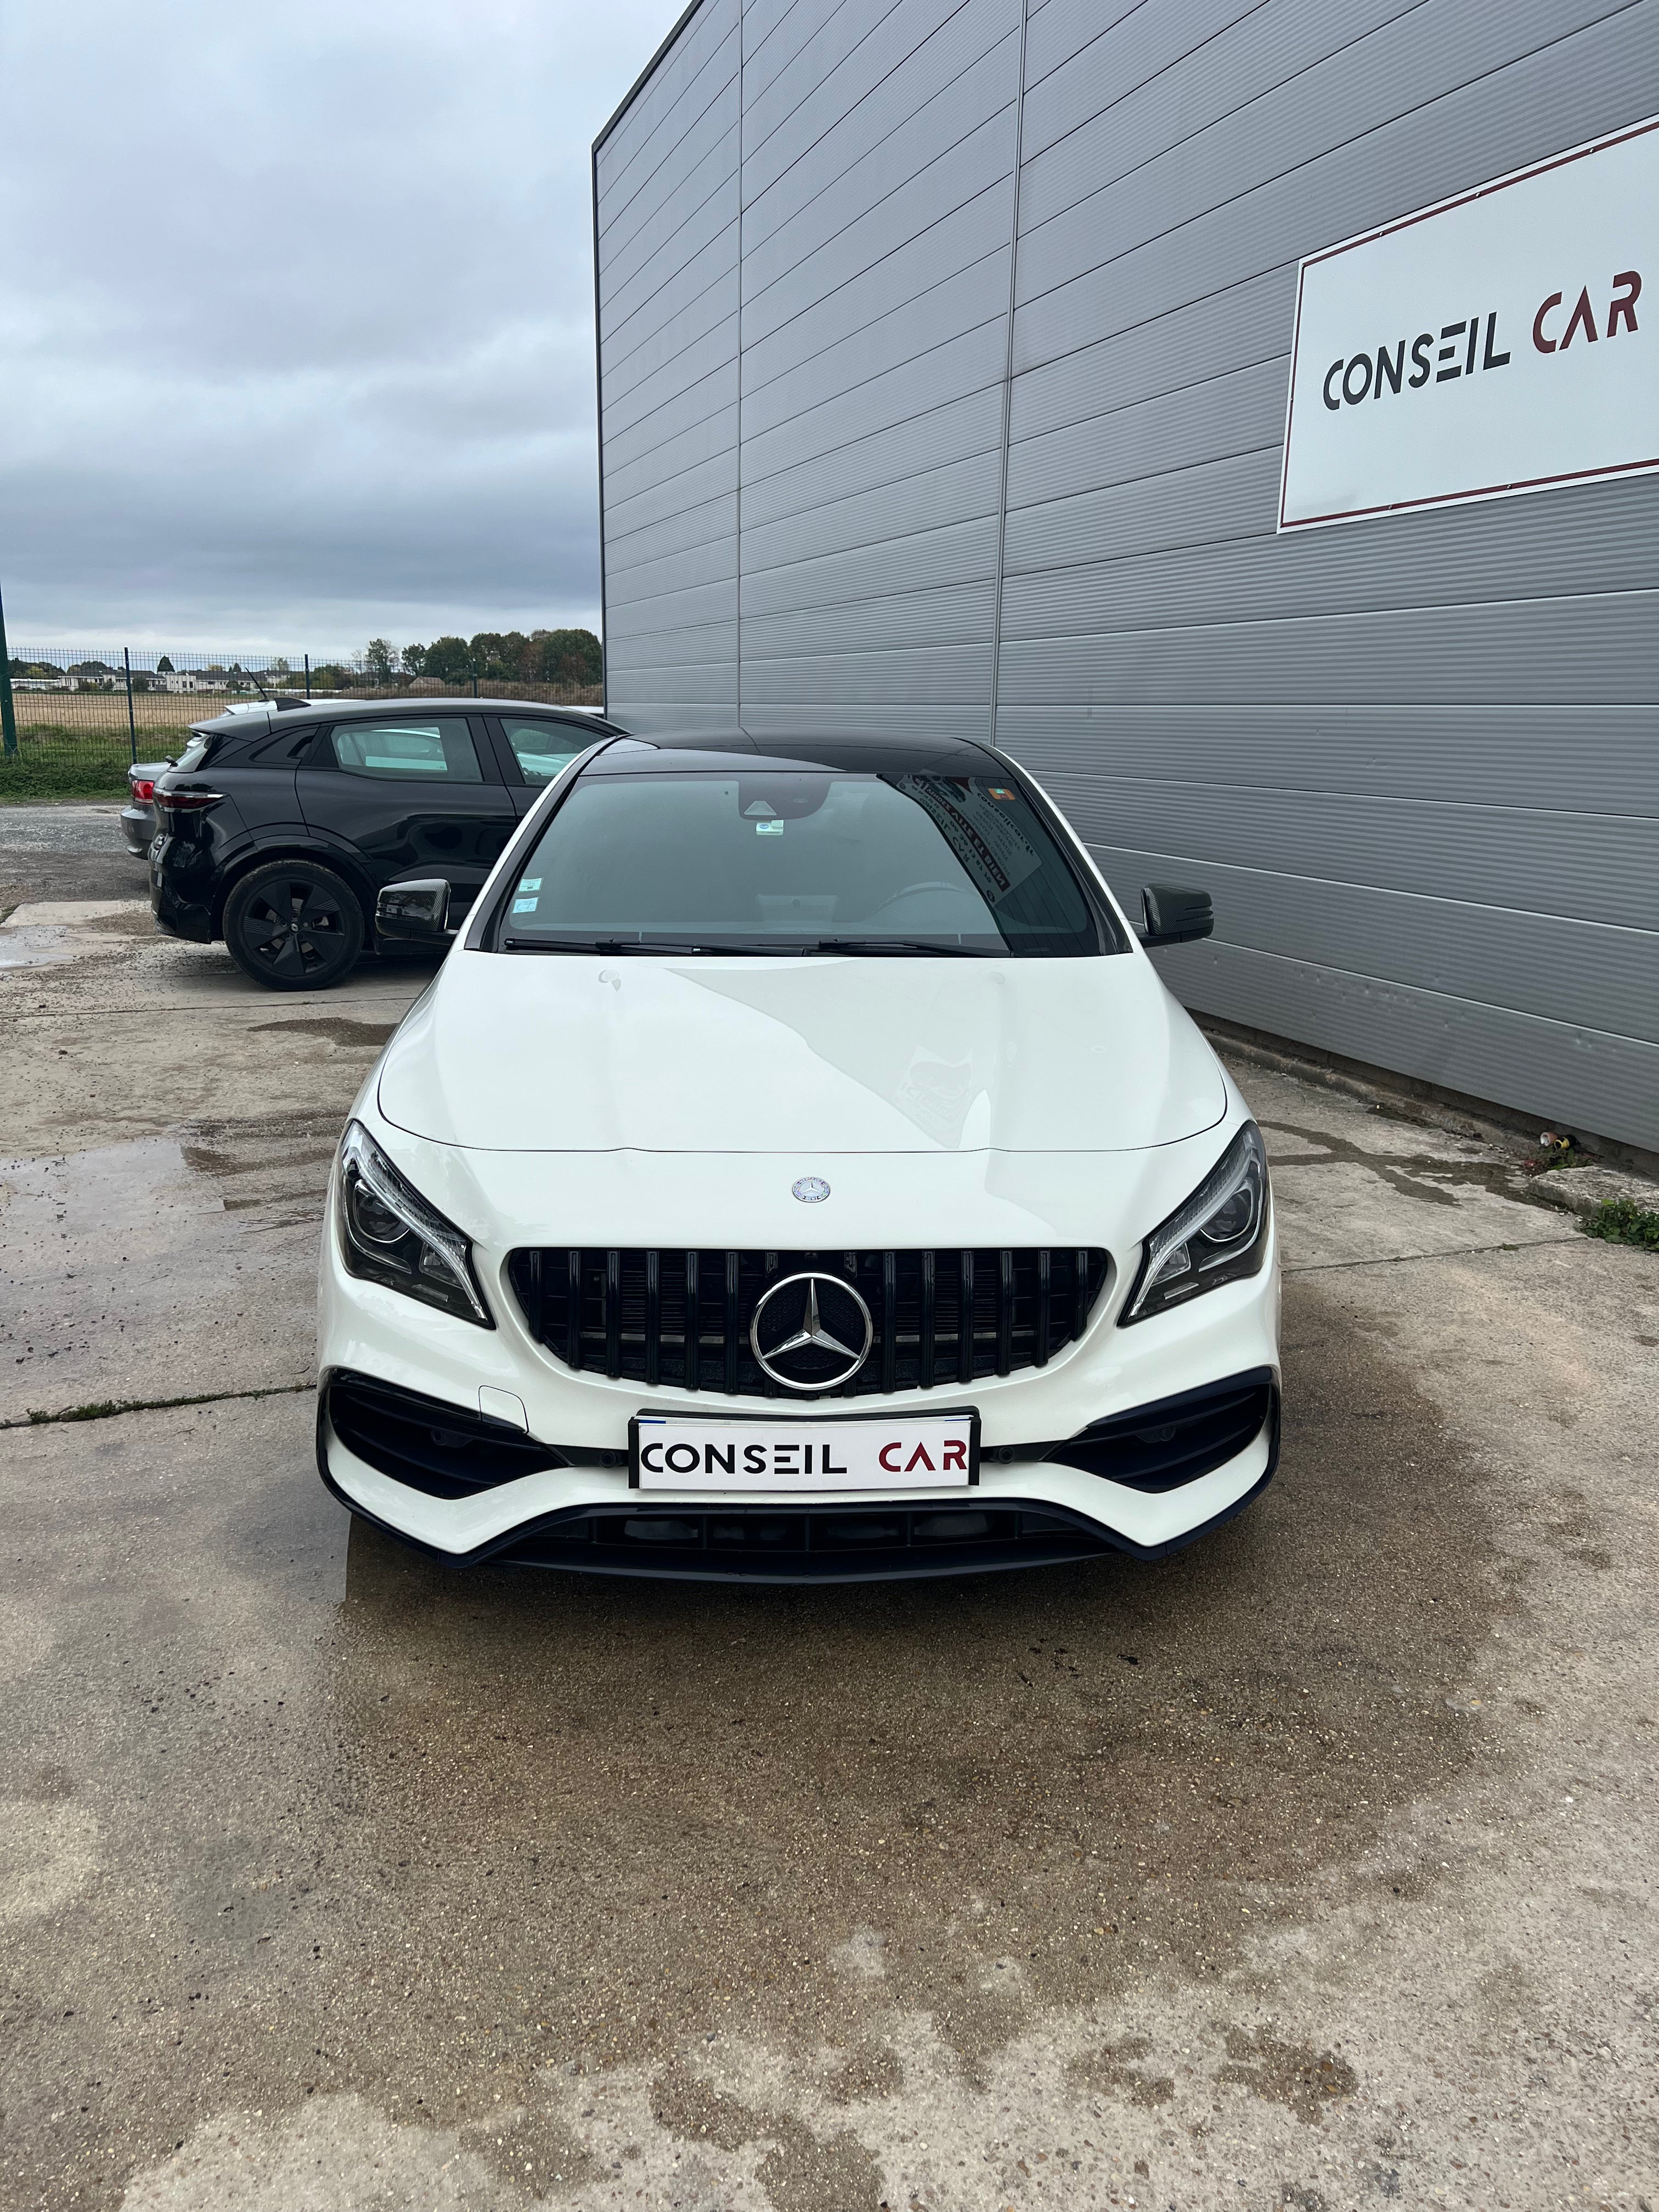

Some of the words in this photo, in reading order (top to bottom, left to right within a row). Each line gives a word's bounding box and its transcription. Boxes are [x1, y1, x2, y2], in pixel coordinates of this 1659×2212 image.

[1323, 311, 1510, 410] CONSEIL
[1533, 271, 1642, 354] CAR
[641, 1443, 847, 1475] CONSEIL
[878, 1440, 967, 1472] CAR
